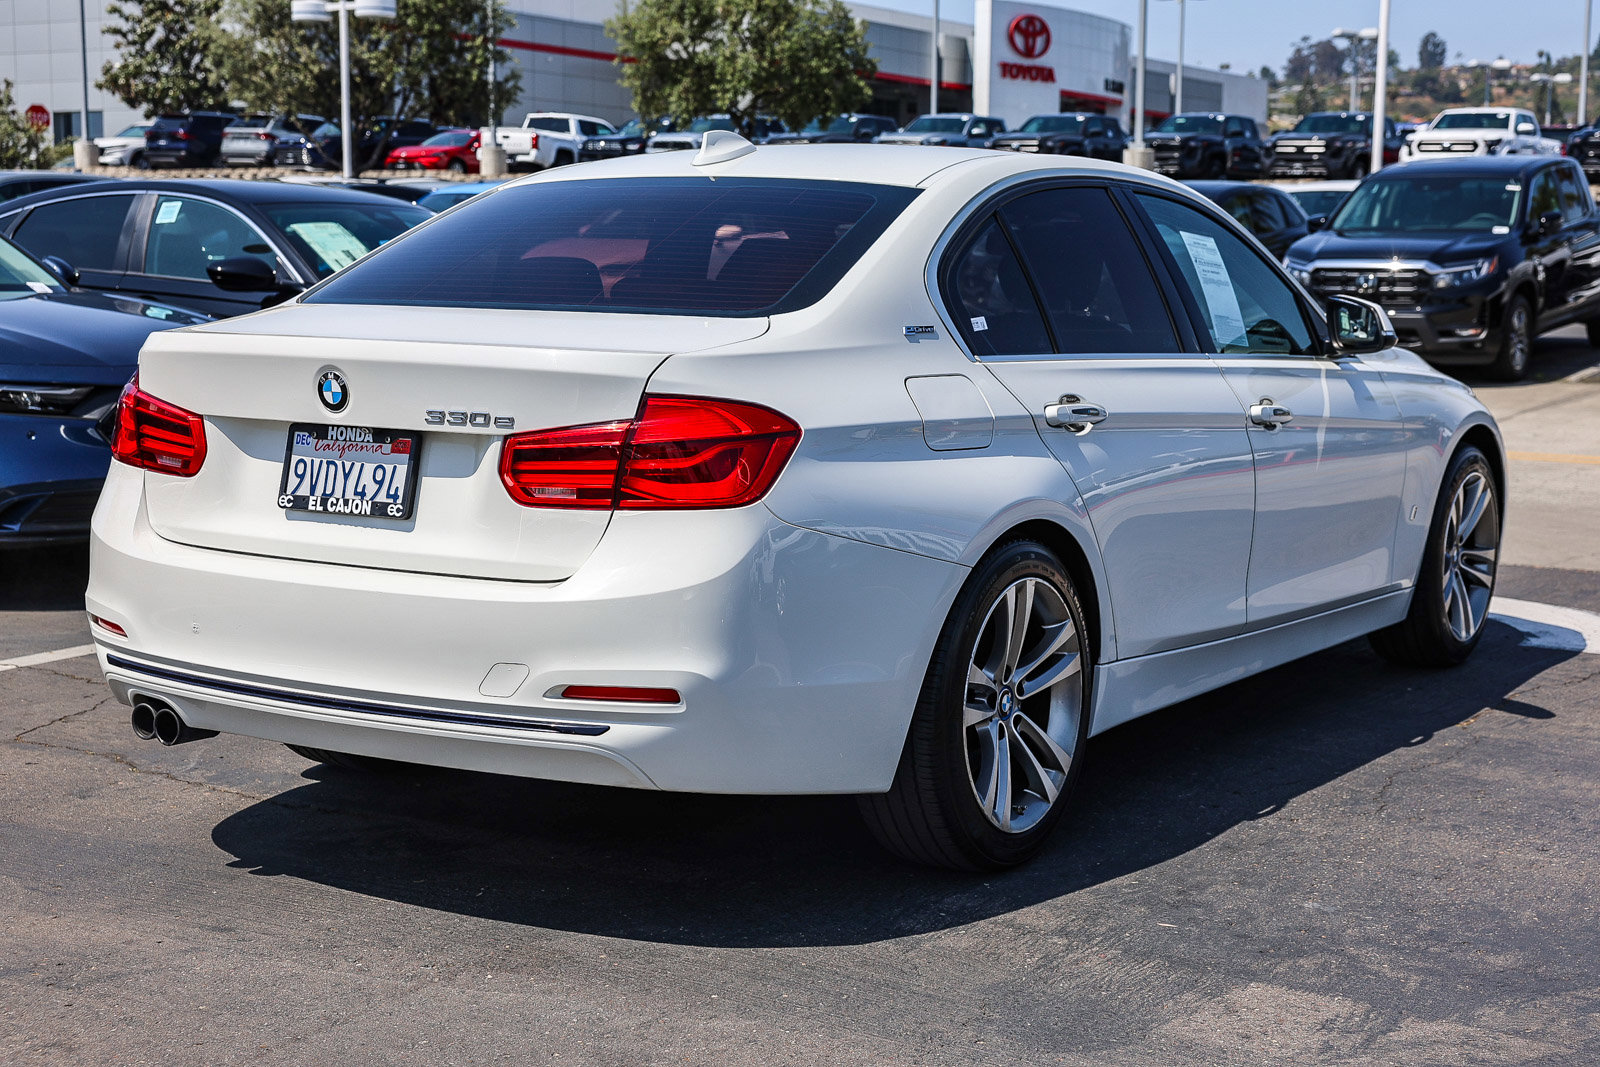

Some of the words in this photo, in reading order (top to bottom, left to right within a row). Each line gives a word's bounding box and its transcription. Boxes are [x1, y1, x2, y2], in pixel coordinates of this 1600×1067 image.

[999, 62, 1056, 83] TOYOTA
[425, 409, 515, 429] 330e
[295, 433, 311, 446] DEC
[328, 426, 374, 443] HONDA
[314, 438, 392, 458] California
[291, 458, 400, 503] 9VDY494
[308, 496, 323, 511] EL
[327, 497, 372, 515] CAJON
